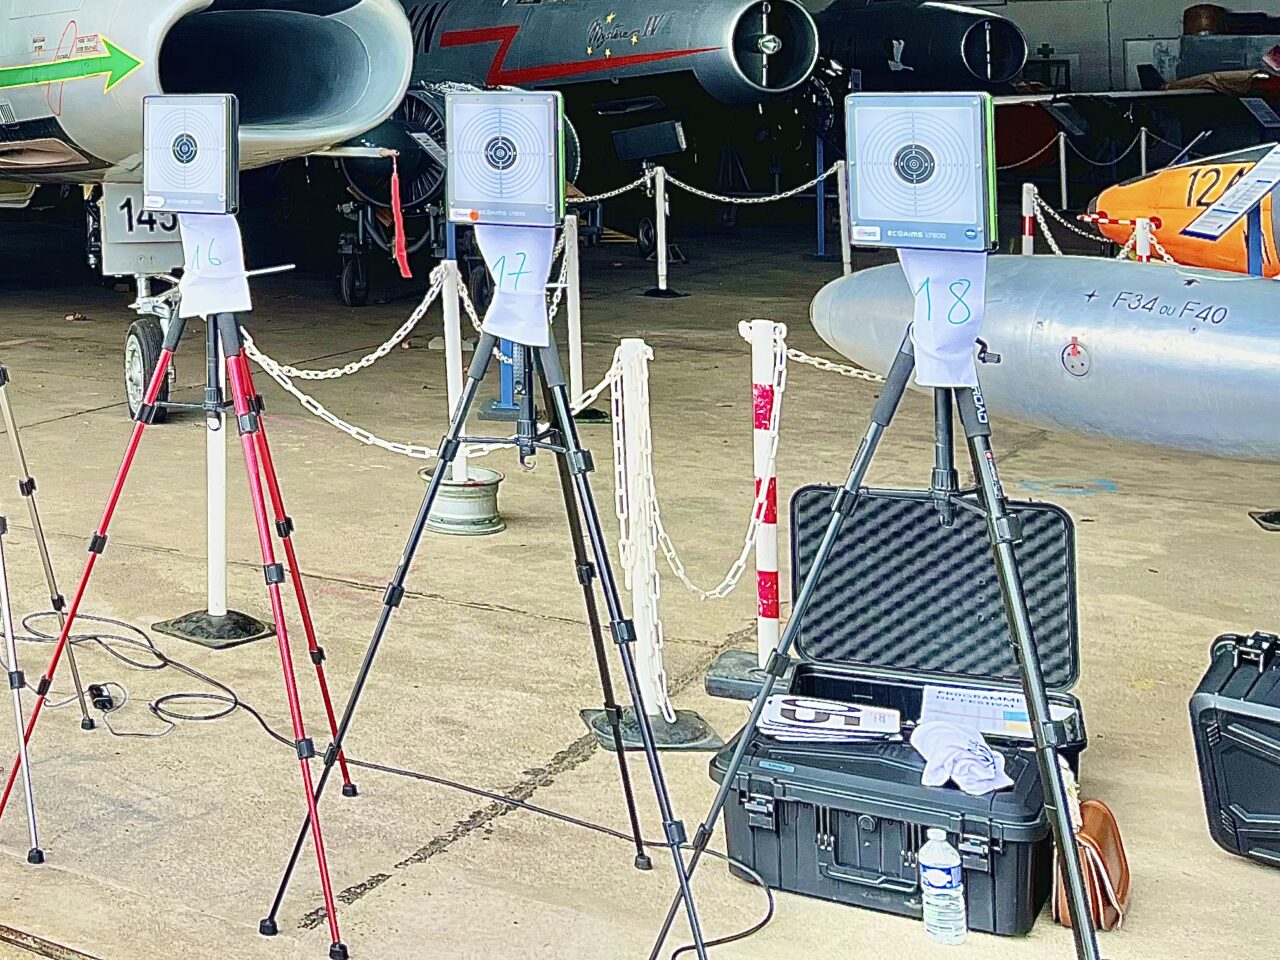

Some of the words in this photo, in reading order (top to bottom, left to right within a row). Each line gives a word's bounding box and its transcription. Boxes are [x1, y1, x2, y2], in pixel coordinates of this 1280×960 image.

[191, 238, 222, 270] 16
[492, 252, 533, 290] 17
[915, 276, 971, 324] 18
[1112, 291, 1160, 313] F34
[1179, 301, 1228, 324] F40
